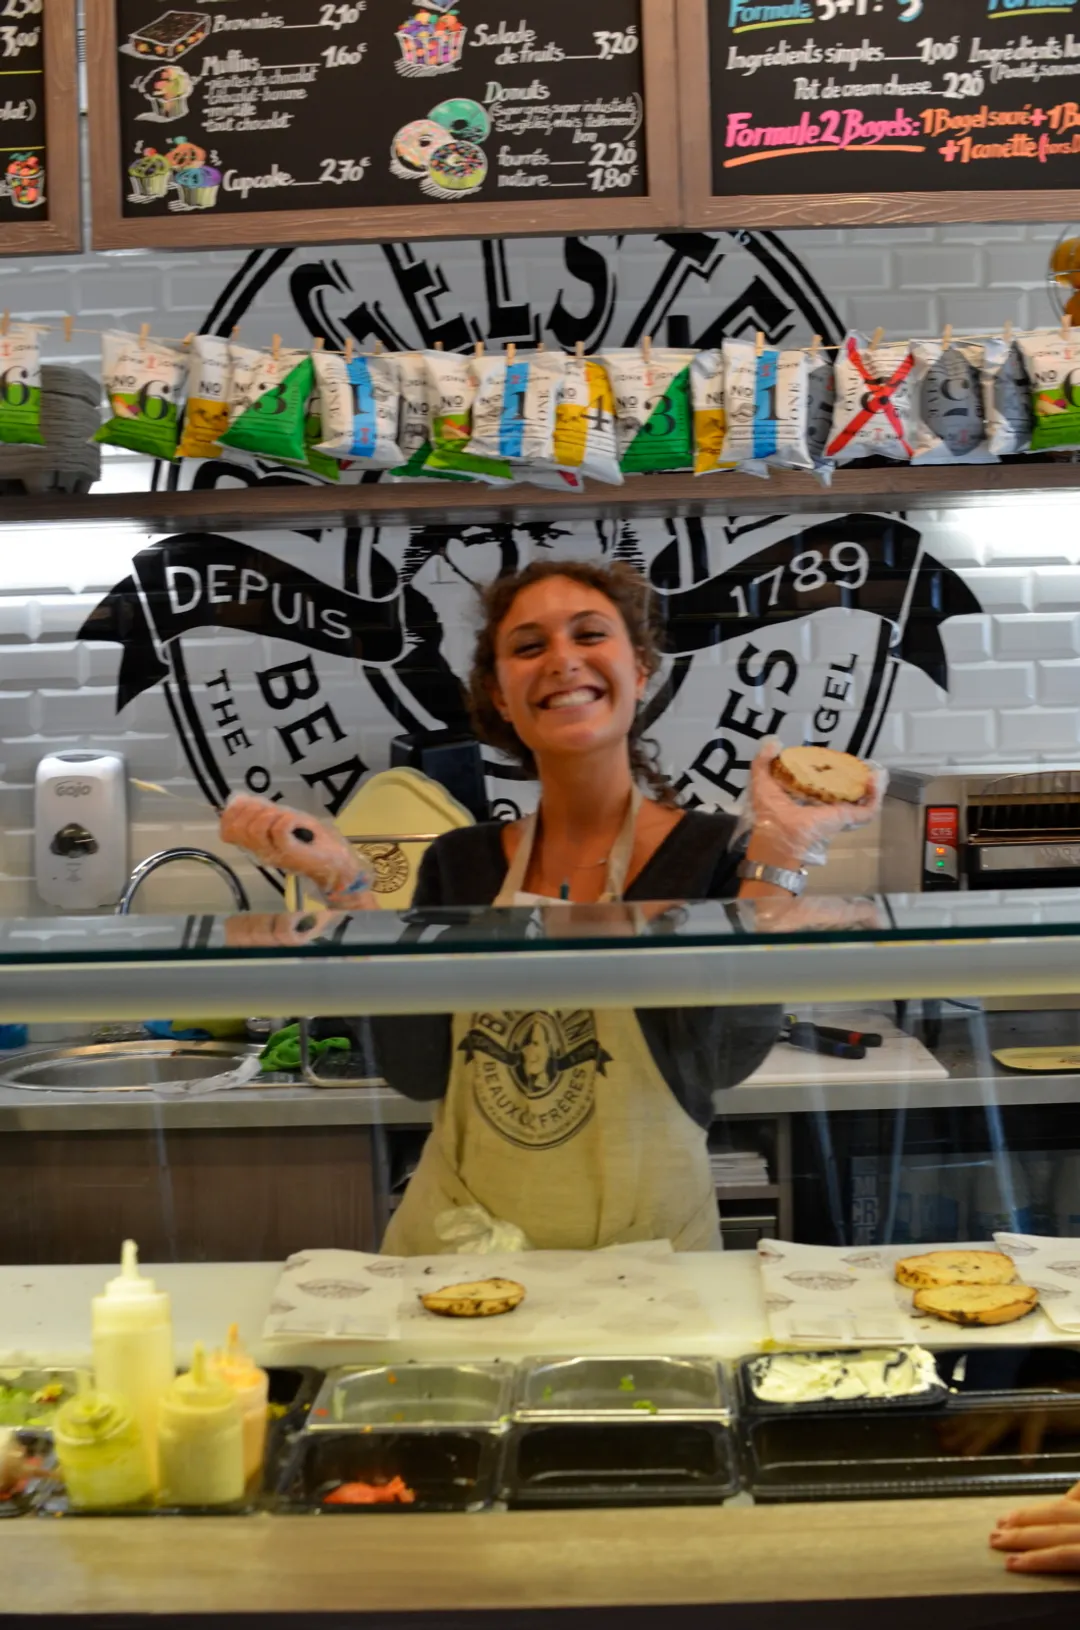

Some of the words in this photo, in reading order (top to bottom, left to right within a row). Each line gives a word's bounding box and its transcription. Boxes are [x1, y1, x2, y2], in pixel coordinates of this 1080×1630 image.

[212, 12, 285, 33] Brownies
[469, 20, 537, 47] Salade
[824, 39, 885, 72] simples
[483, 79, 550, 103] Donuts
[725, 111, 820, 147] Formule
[223, 164, 295, 198] Cupcake
[497, 169, 550, 187] nature
[138, 379, 169, 420] 6
[643, 394, 676, 436] 3
[728, 541, 870, 618] 1789
[164, 563, 353, 640] DEPUIS
[206, 668, 253, 757] THE
[255, 654, 370, 816] BEA
